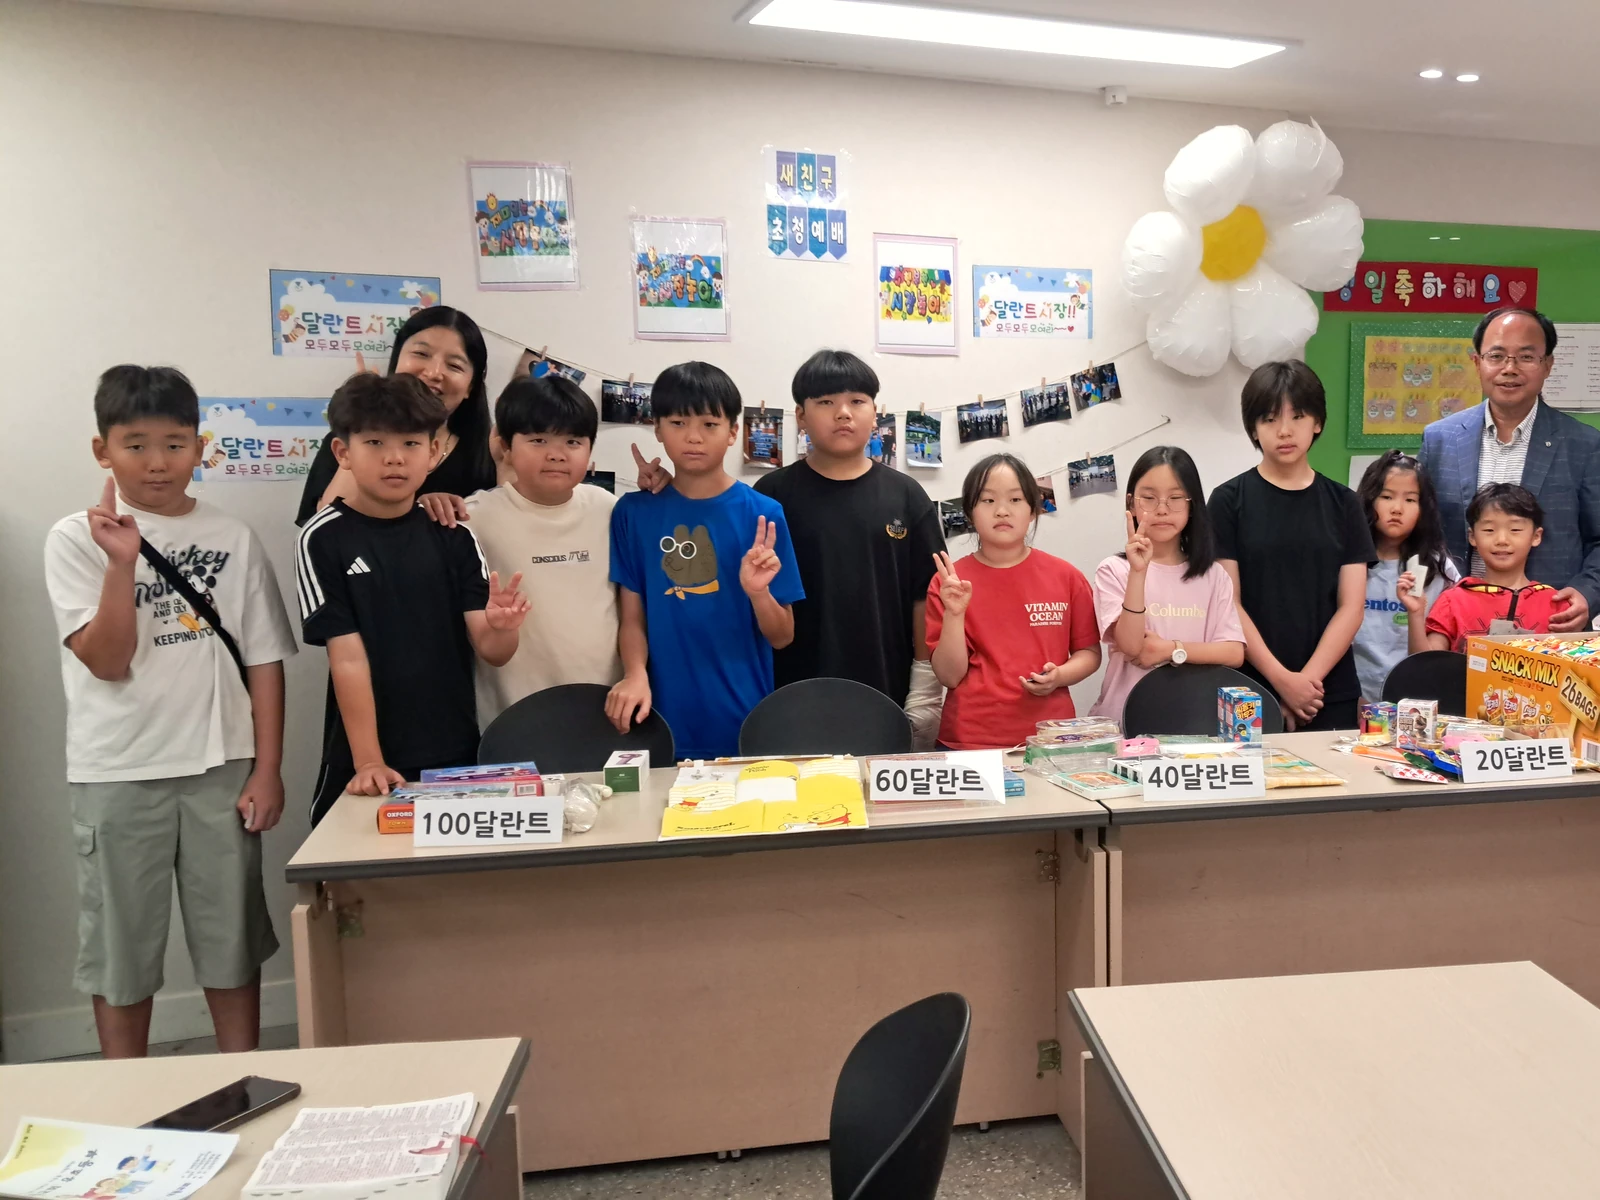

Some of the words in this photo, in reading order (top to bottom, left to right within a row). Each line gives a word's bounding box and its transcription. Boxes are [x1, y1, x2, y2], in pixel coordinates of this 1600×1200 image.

[780, 163, 833, 191] 새친구
[771, 215, 844, 245] 초청예배
[659, 272, 713, 304] 시장놀이
[891, 288, 941, 317] 시장놀이
[153, 608, 171, 618] AND
[154, 600, 171, 610] THE
[1025, 602, 1069, 612] VITAMIN
[1029, 611, 1064, 622] OCEAN
[153, 630, 198, 647] KEEPING
[1490, 648, 1534, 680] SNACK
[1534, 659, 1560, 688] MIX
[1475, 745, 1568, 773] 20달란트
[875, 769, 985, 796] 60달란트
[1147, 764, 1253, 791] 40달란트
[422, 810, 552, 839] 100달란트
